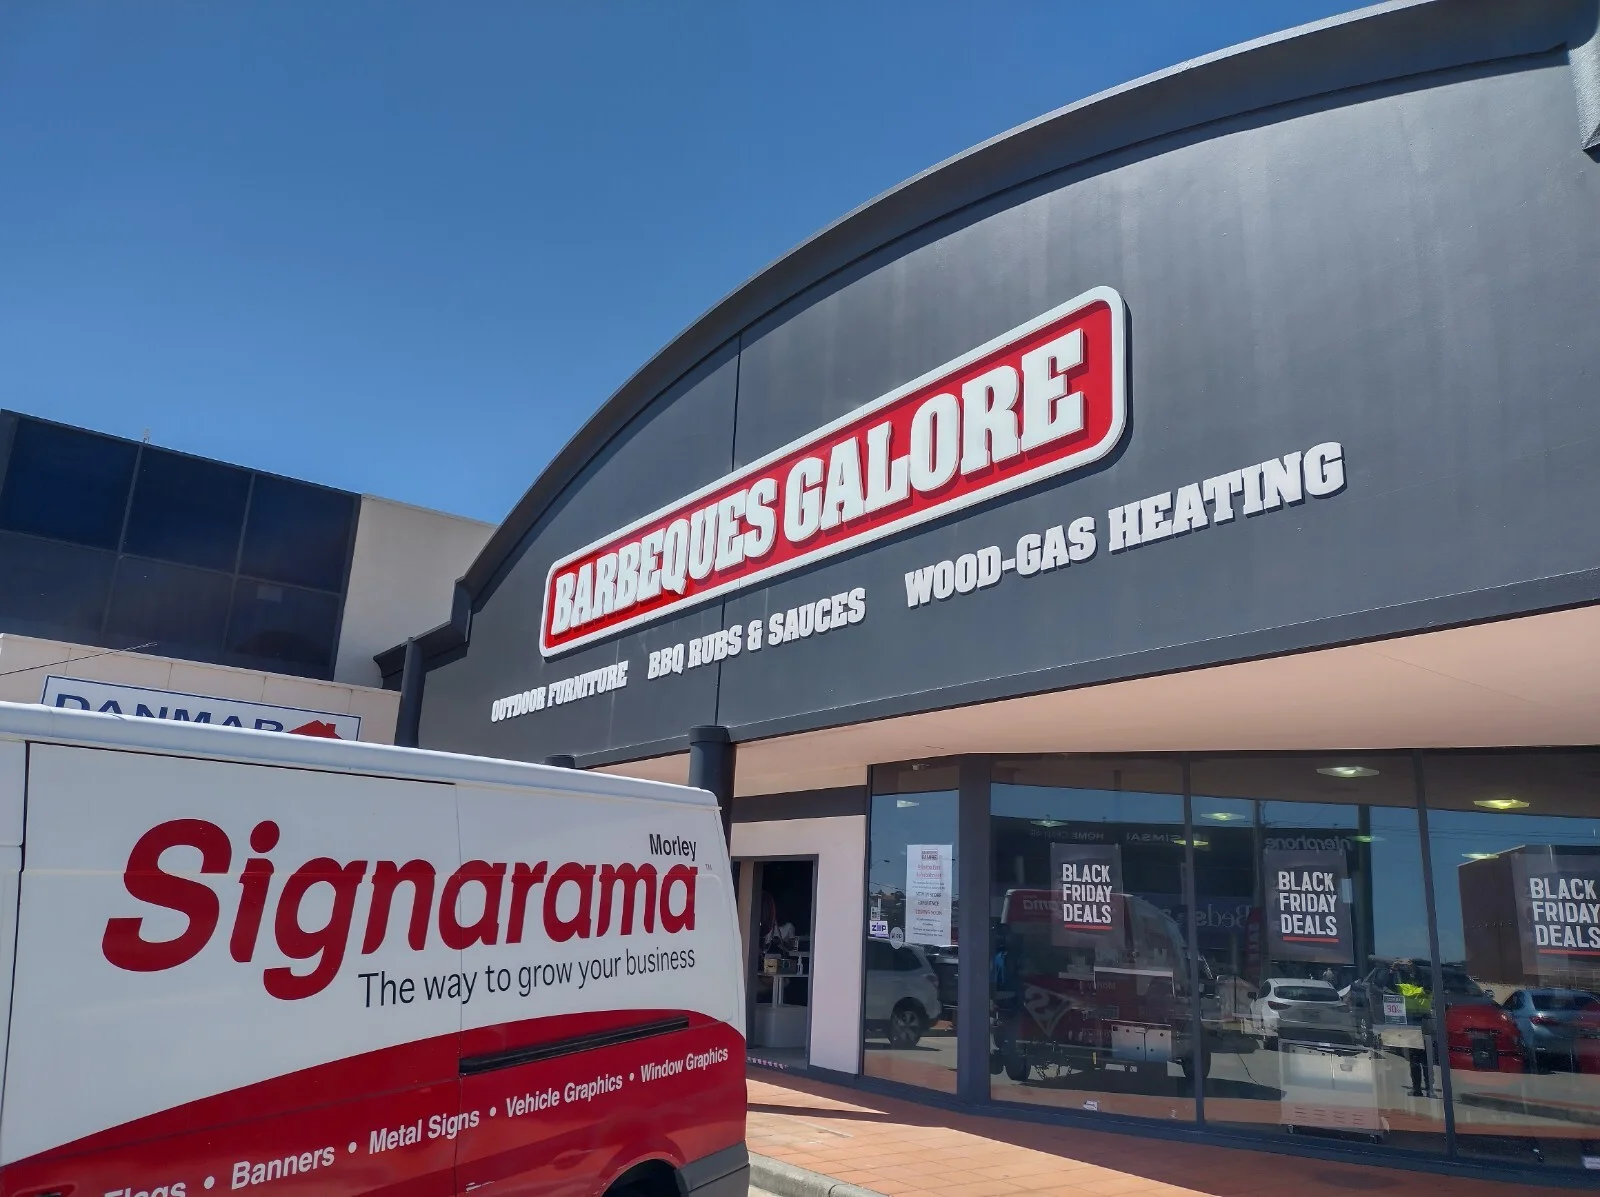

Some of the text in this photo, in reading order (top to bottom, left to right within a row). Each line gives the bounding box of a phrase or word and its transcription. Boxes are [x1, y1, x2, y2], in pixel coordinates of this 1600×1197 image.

[551, 328, 1084, 635] BARBEQUES GALORE
[904, 441, 1346, 608] WOOD-GAS HEATING
[647, 587, 867, 680] BBQ RUBS & SAUCES
[491, 660, 629, 723] OUTDOOR FURNITURE
[649, 833, 697, 861] Morley
[1062, 863, 1111, 883] BLACK
[1278, 871, 1335, 891] BLACK
[1062, 884, 1113, 903] FRIDAY
[1529, 878, 1597, 900] BLACK
[102, 818, 698, 1000] Signarama
[1063, 903, 1112, 924] DEALS
[1280, 893, 1337, 912] FRIDAY
[1532, 901, 1600, 924] FRIDAY
[1280, 914, 1338, 936] DEALS
[1535, 925, 1600, 948] DEALS
[358, 948, 695, 1008] The way to grow your business
[231, 1145, 335, 1190] Banners
[369, 1119, 421, 1154] Metal
[428, 1109, 480, 1140] Signs
[506, 1088, 560, 1118] Vehicle
[564, 1073, 623, 1103] Graphics
[641, 1058, 684, 1083] Window
[686, 1046, 729, 1071] Graphics
